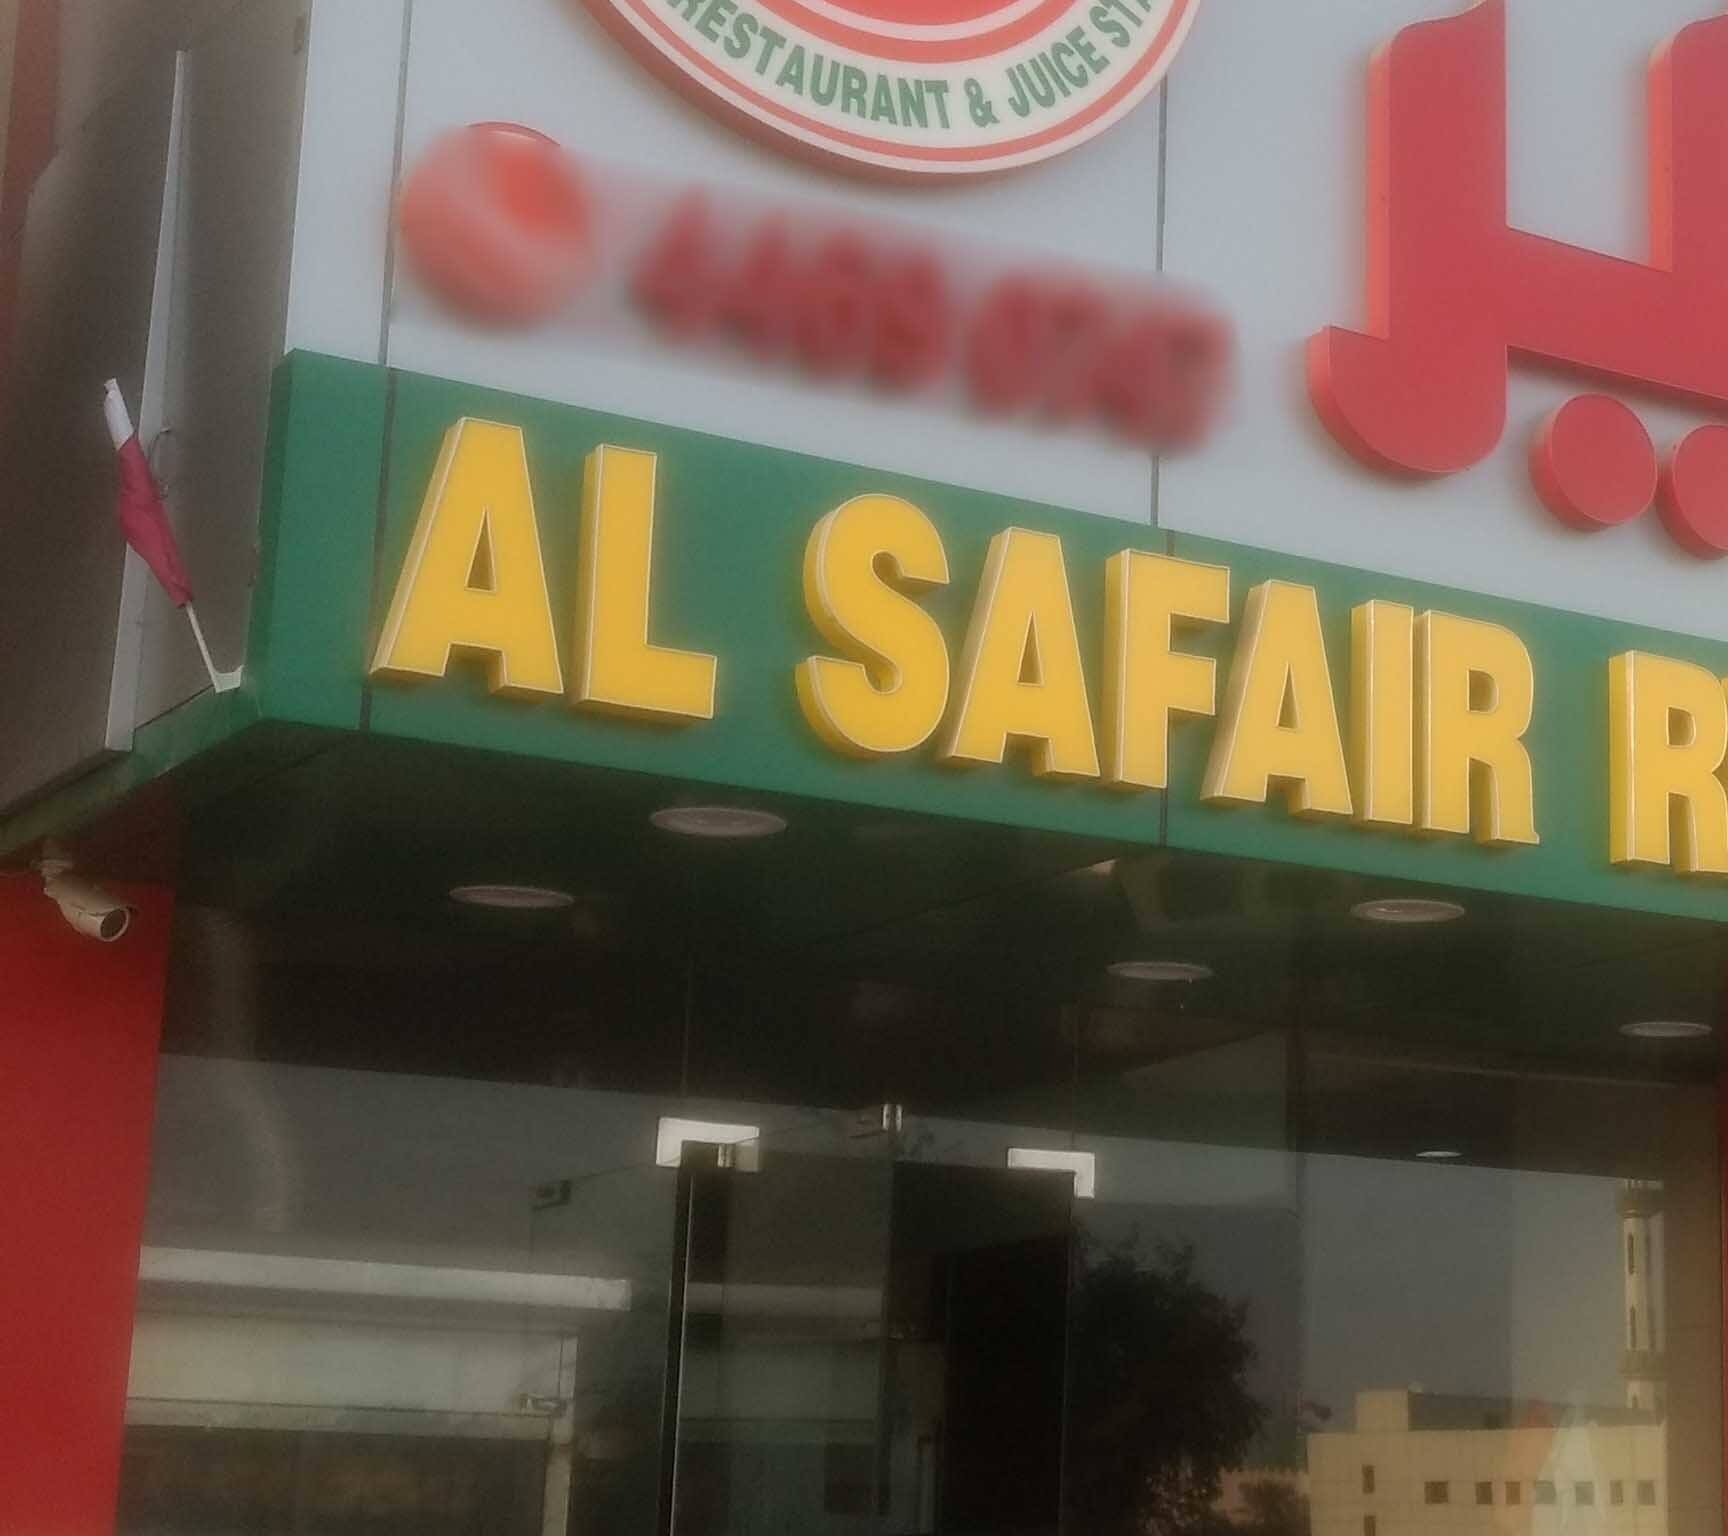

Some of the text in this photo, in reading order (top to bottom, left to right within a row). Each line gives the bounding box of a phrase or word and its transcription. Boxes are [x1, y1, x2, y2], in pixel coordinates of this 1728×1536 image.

[965, 78, 999, 128] &
[1005, 25, 1107, 119] JUICE
[367, 415, 719, 726] AL
[793, 491, 1542, 848] SAFAIR
